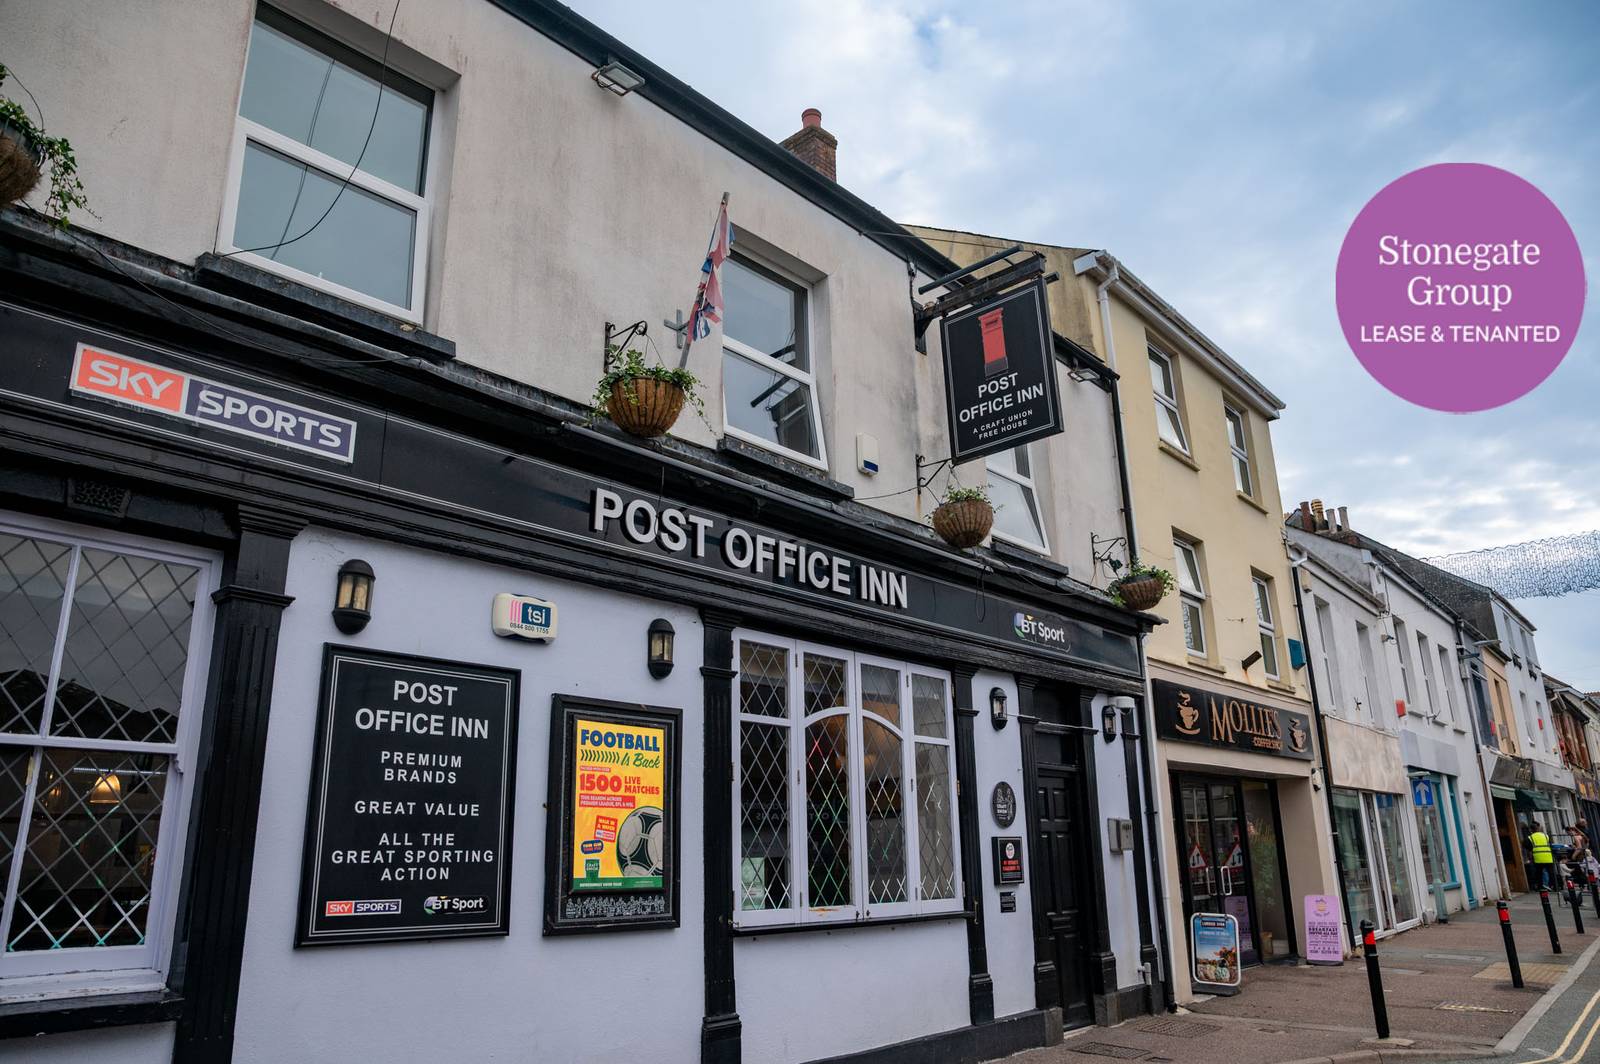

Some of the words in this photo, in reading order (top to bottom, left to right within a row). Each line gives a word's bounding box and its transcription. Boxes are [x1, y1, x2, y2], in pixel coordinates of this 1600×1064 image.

[977, 372, 1019, 398] POST
[88, 359, 174, 400] SKY
[197, 389, 342, 448] SPORTS
[959, 394, 1014, 423] OFFICE
[1017, 383, 1044, 404] INN
[978, 428, 998, 440] FREE
[1001, 418, 1028, 432] HOUSE
[980, 417, 1006, 431] CRAFT
[1008, 409, 1033, 422] UNION
[594, 487, 713, 557] POST
[725, 527, 851, 595] OFFICE
[860, 564, 908, 609] INN
[527, 606, 546, 625] tsi
[1021, 619, 1037, 635] BT
[1038, 622, 1065, 643] Sport
[393, 680, 458, 706] POST
[355, 708, 444, 736] OFFICE
[451, 716, 489, 739] INN
[1210, 695, 1281, 744] MOLLIE'S
[581, 729, 660, 752] FOOTBALL
[381, 751, 462, 768] PREMIUM
[621, 752, 630, 766] Is
[633, 752, 660, 769] Back
[384, 768, 457, 784] BRANDS
[580, 773, 622, 793] 1500
[624, 776, 641, 785] LIVE
[624, 784, 660, 795] MATCHES
[354, 800, 416, 815] GREAT
[425, 803, 480, 817] VALUE
[378, 833, 413, 846] ALL
[422, 833, 455, 846] THE
[331, 850, 395, 864] GREAT
[404, 850, 494, 863] SPORTING
[380, 867, 449, 881] ACTION
[329, 903, 351, 913] SKY
[357, 902, 397, 912] SPORTS
[433, 899, 450, 910] BT
[452, 898, 483, 911] Sport
